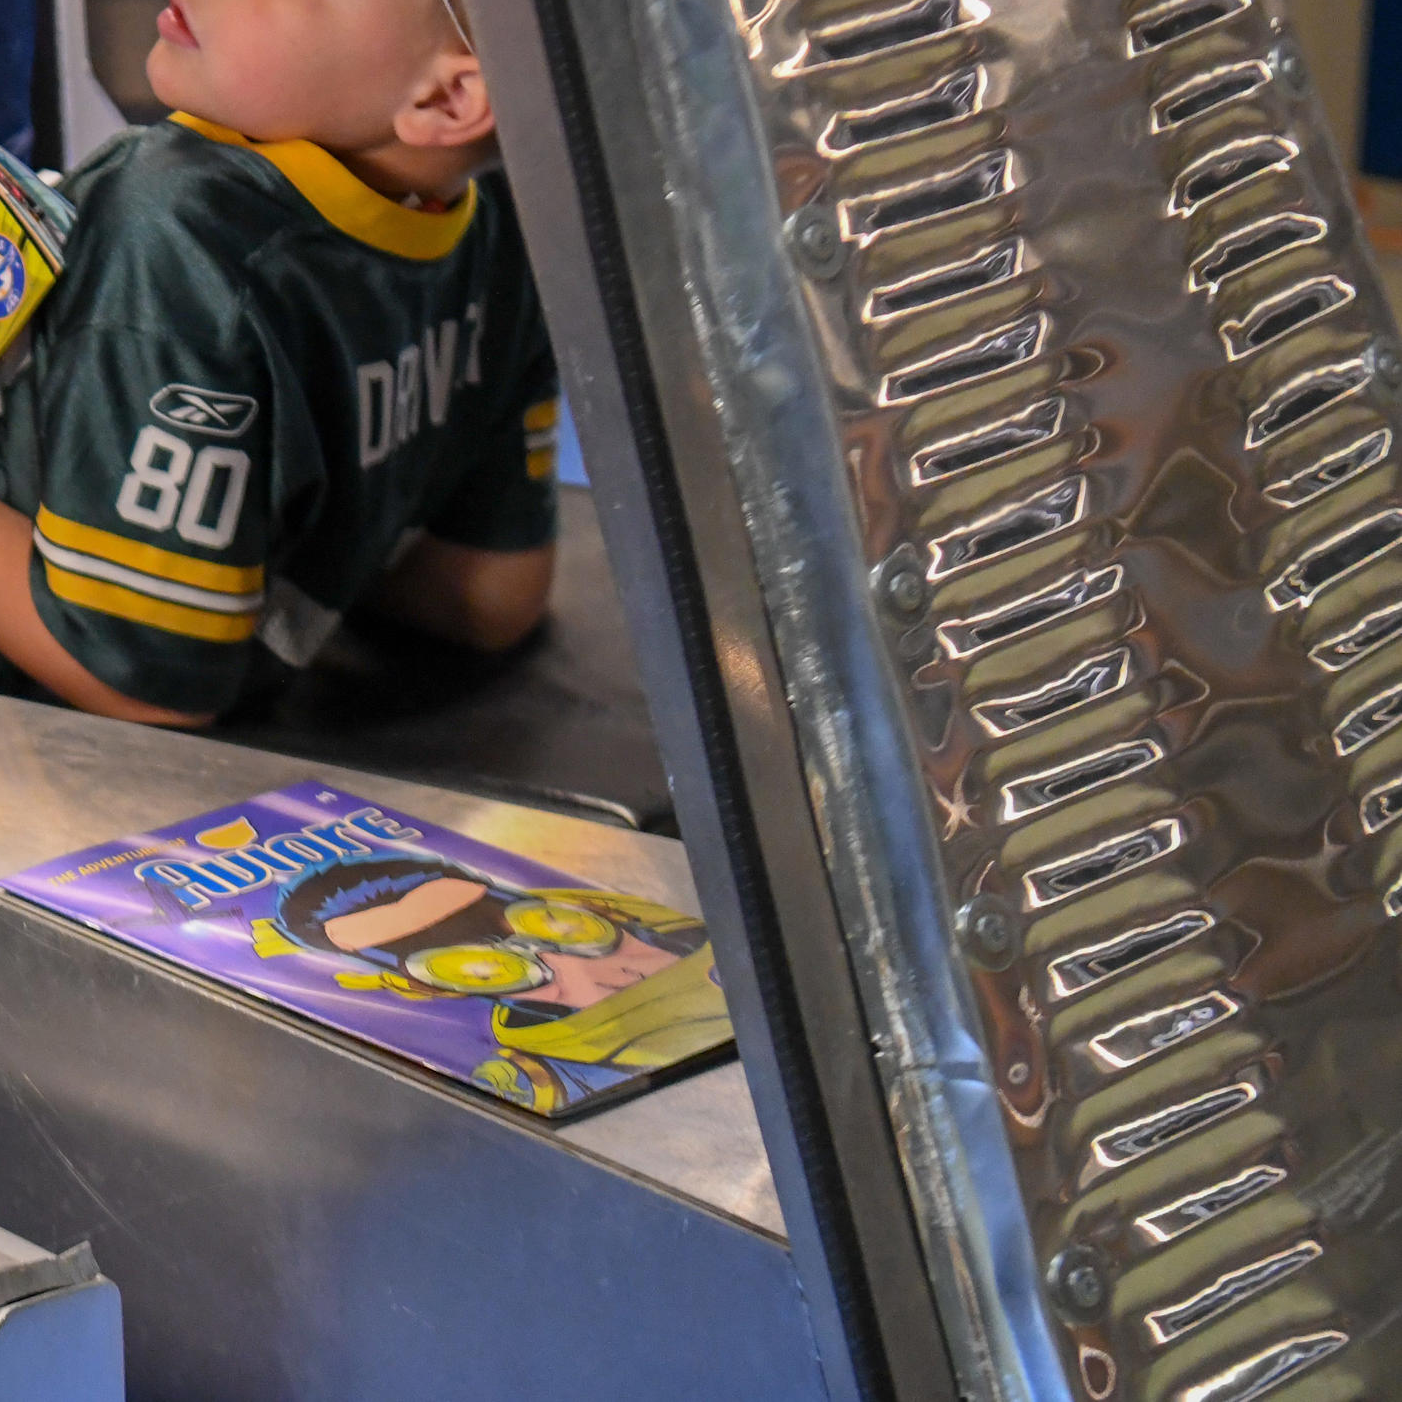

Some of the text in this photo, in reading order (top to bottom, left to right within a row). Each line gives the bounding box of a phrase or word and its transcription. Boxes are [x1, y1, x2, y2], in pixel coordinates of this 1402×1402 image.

[116, 424, 251, 551] 80
[49, 870, 77, 886] THE
[78, 843, 166, 876] ADVENTURE
